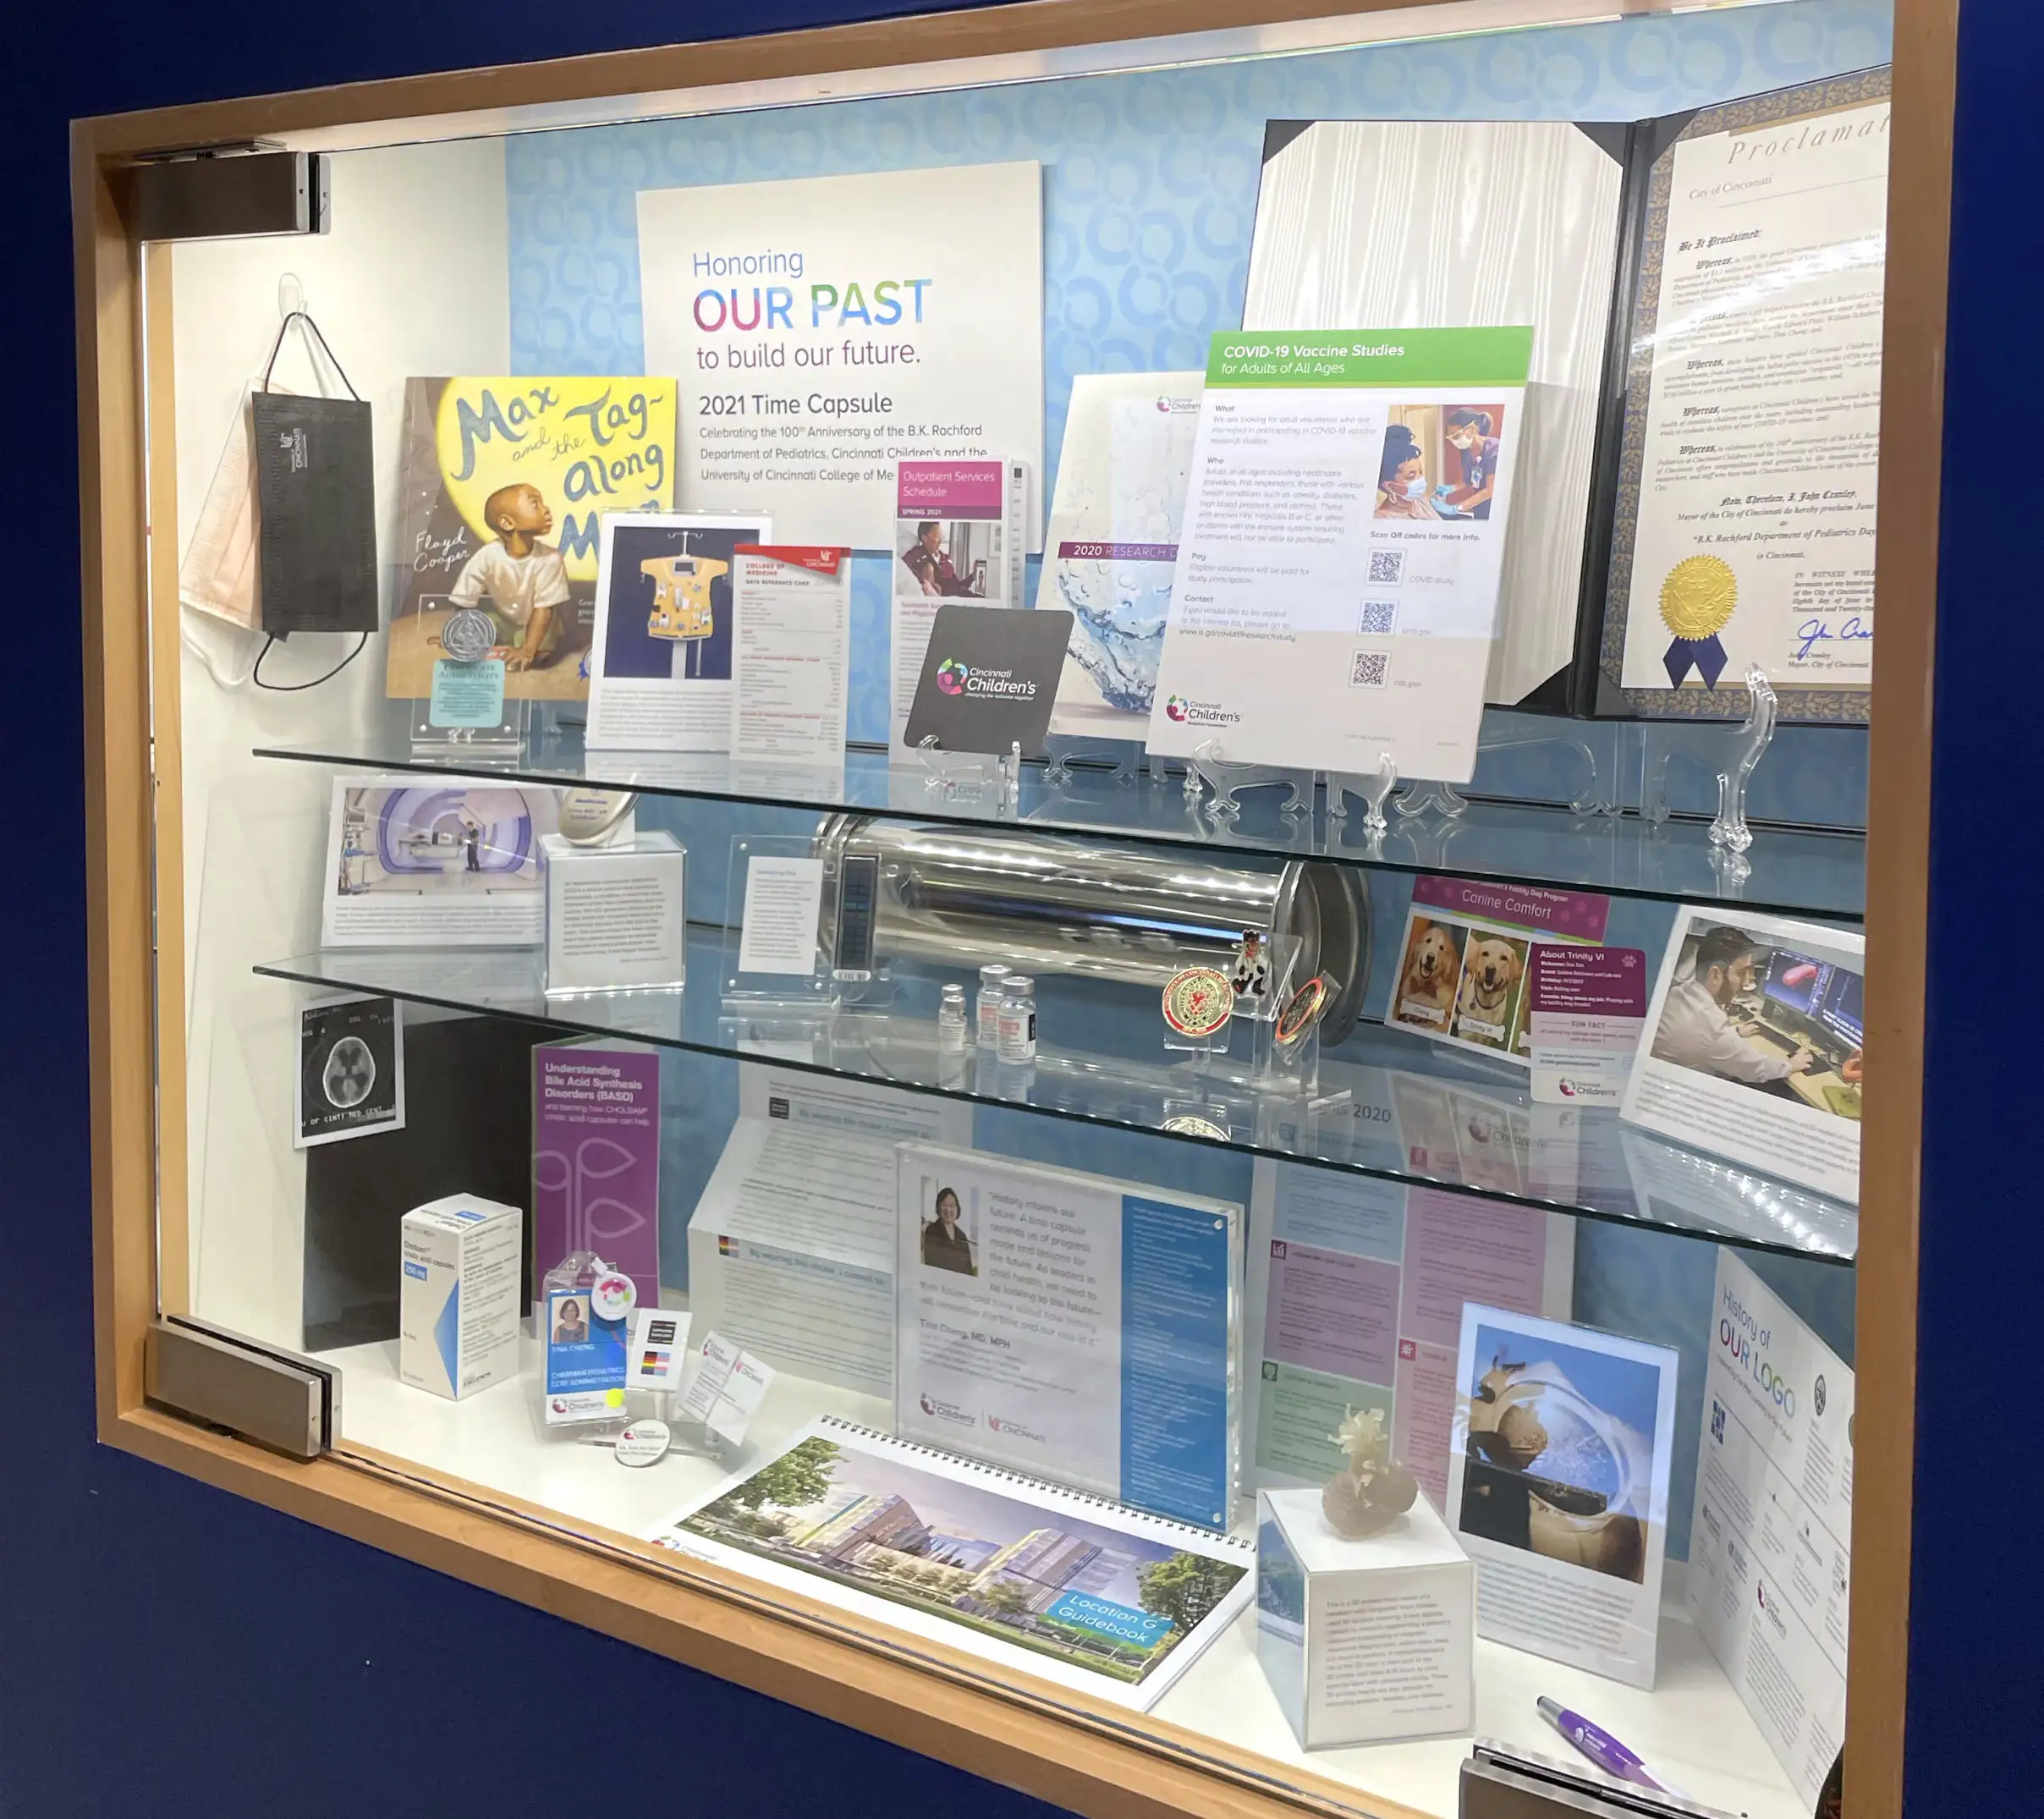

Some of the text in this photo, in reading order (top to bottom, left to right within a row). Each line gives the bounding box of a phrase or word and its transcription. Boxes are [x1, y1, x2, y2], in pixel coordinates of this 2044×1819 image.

[1727, 114, 1891, 165] Proclamat
[1689, 175, 1772, 200] City of Cincinnati
[694, 249, 804, 278] Honoring
[694, 278, 932, 332] OUR PAST
[697, 340, 920, 369] to build our future.
[1224, 344, 1405, 358] COVID-19 Vaccine Studies
[1222, 362, 1345, 376] for Adults of All Ages
[700, 393, 893, 419] 2021 Time Capsule
[1171, 402, 1201, 411] Children
[563, 383, 664, 447] Tag-
[451, 387, 559, 481] Max
[700, 427, 758, 440] Celebrating
[761, 427, 777, 437] the
[807, 426, 870, 439] Anniversary
[874, 426, 884, 436] of
[887, 426, 904, 437] the
[908, 426, 929, 436] B.K.
[512, 426, 585, 462] and the
[701, 448, 760, 461] Department
[763, 448, 773, 459] of
[776, 448, 829, 460] Pediatrics,
[832, 448, 884, 459] Cincinnati
[887, 448, 940, 458] Children's
[969, 448, 987, 457] the
[701, 470, 750, 483] University
[753, 470, 763, 480] of
[766, 469, 816, 481] Cincinnati
[819, 470, 860, 483] College
[864, 469, 874, 480] of
[903, 471, 953, 483] Outpatient
[955, 470, 995, 481] Services
[903, 486, 948, 497] Schedule
[1745, 508, 1782, 518] Cincinnati
[1794, 506, 1818, 515] hereby
[1819, 504, 1854, 514] proclaim
[415, 526, 467, 553] Floyd
[1404, 531, 1426, 540] codes
[1463, 533, 1481, 541] info.
[1754, 531, 1801, 544] Department
[1803, 530, 1813, 540] of
[1814, 529, 1856, 539] Pediatrics
[1074, 545, 1102, 555] 2020
[1105, 546, 1171, 558] RESEARCH
[1191, 552, 1206, 562] Pay
[414, 550, 470, 573] Cooper
[1184, 595, 1213, 603] Contact
[970, 667, 1012, 678] Cincinnati
[967, 678, 1036, 695] Children's
[1190, 701, 1222, 710] Cincinnati
[1189, 709, 1241, 723] Children's
[1530, 888, 1543, 899] Dog
[1543, 892, 1569, 903] Program
[1462, 889, 1552, 920] Canine Comfort
[1540, 950, 1605, 962] About Trinity VI
[545, 1063, 621, 1078] Understanding
[545, 1074, 643, 1090] Bile Acid Synthesis
[545, 1088, 635, 1103] Disorders (BASD)
[1576, 1086, 1617, 1097] Children's
[1354, 1103, 1392, 1124] 2020
[1723, 1286, 1771, 1349] History of
[920, 1318, 938, 1331] Tina
[940, 1324, 969, 1340] Cheng,
[991, 1337, 1011, 1349] MPH
[1720, 1318, 1750, 1370] OUR
[1753, 1351, 1795, 1420] LOGO
[1069, 1594, 1140, 1625] Location
[1143, 1617, 1158, 1629] G
[1058, 1606, 1149, 1643] Guidebook
